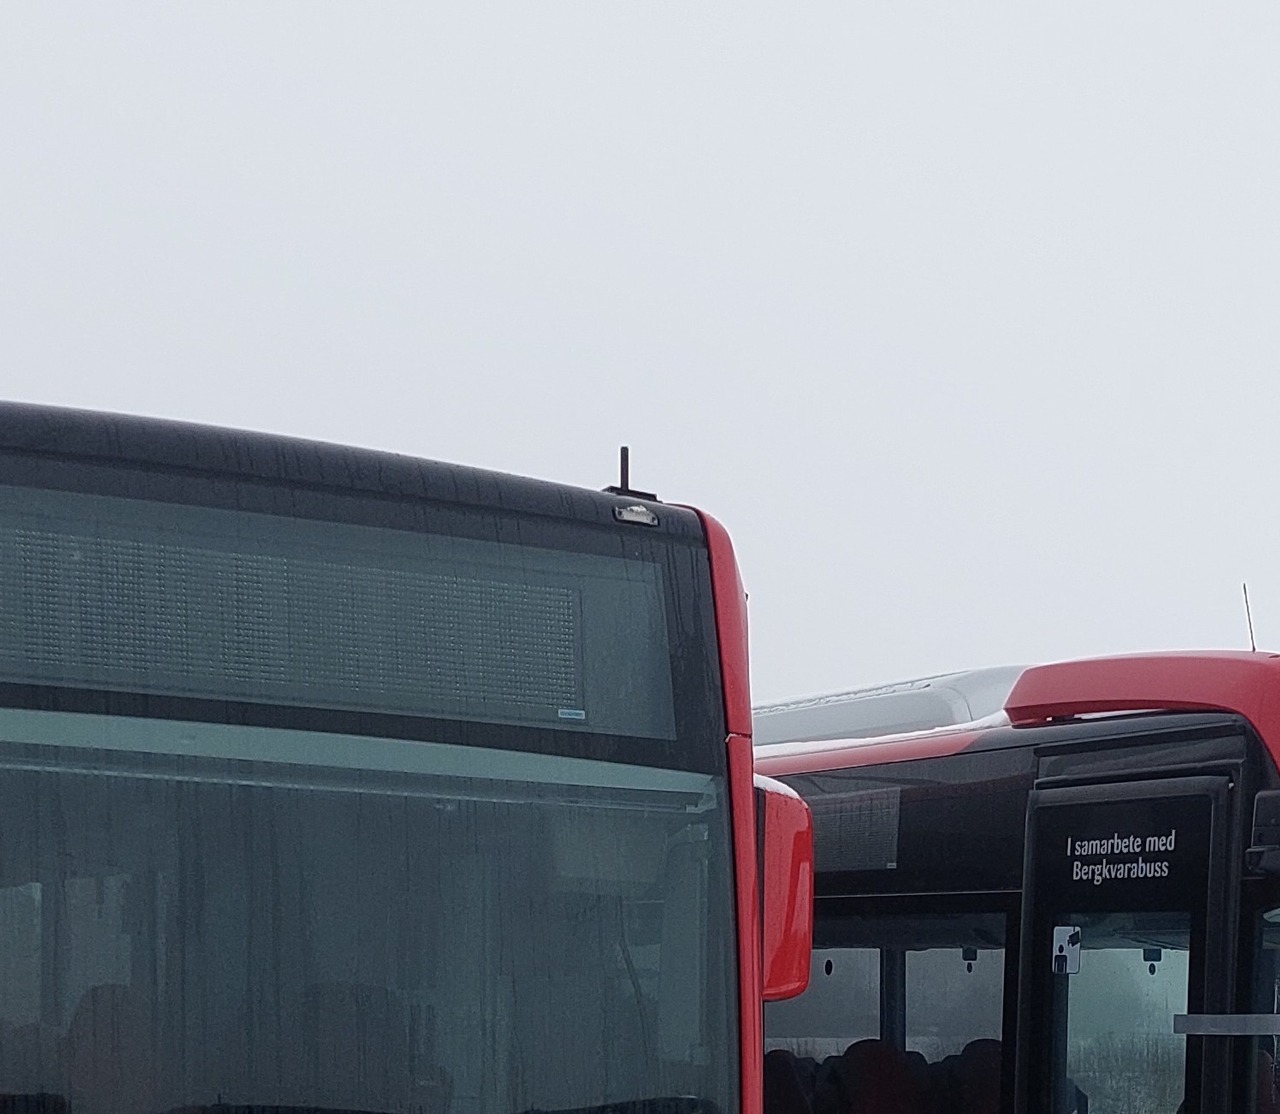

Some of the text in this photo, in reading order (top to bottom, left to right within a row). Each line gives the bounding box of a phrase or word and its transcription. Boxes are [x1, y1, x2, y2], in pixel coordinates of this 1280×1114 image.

[1066, 829, 1176, 856] I samarbete med
[1072, 857, 1169, 885] Bergkvarabuss
